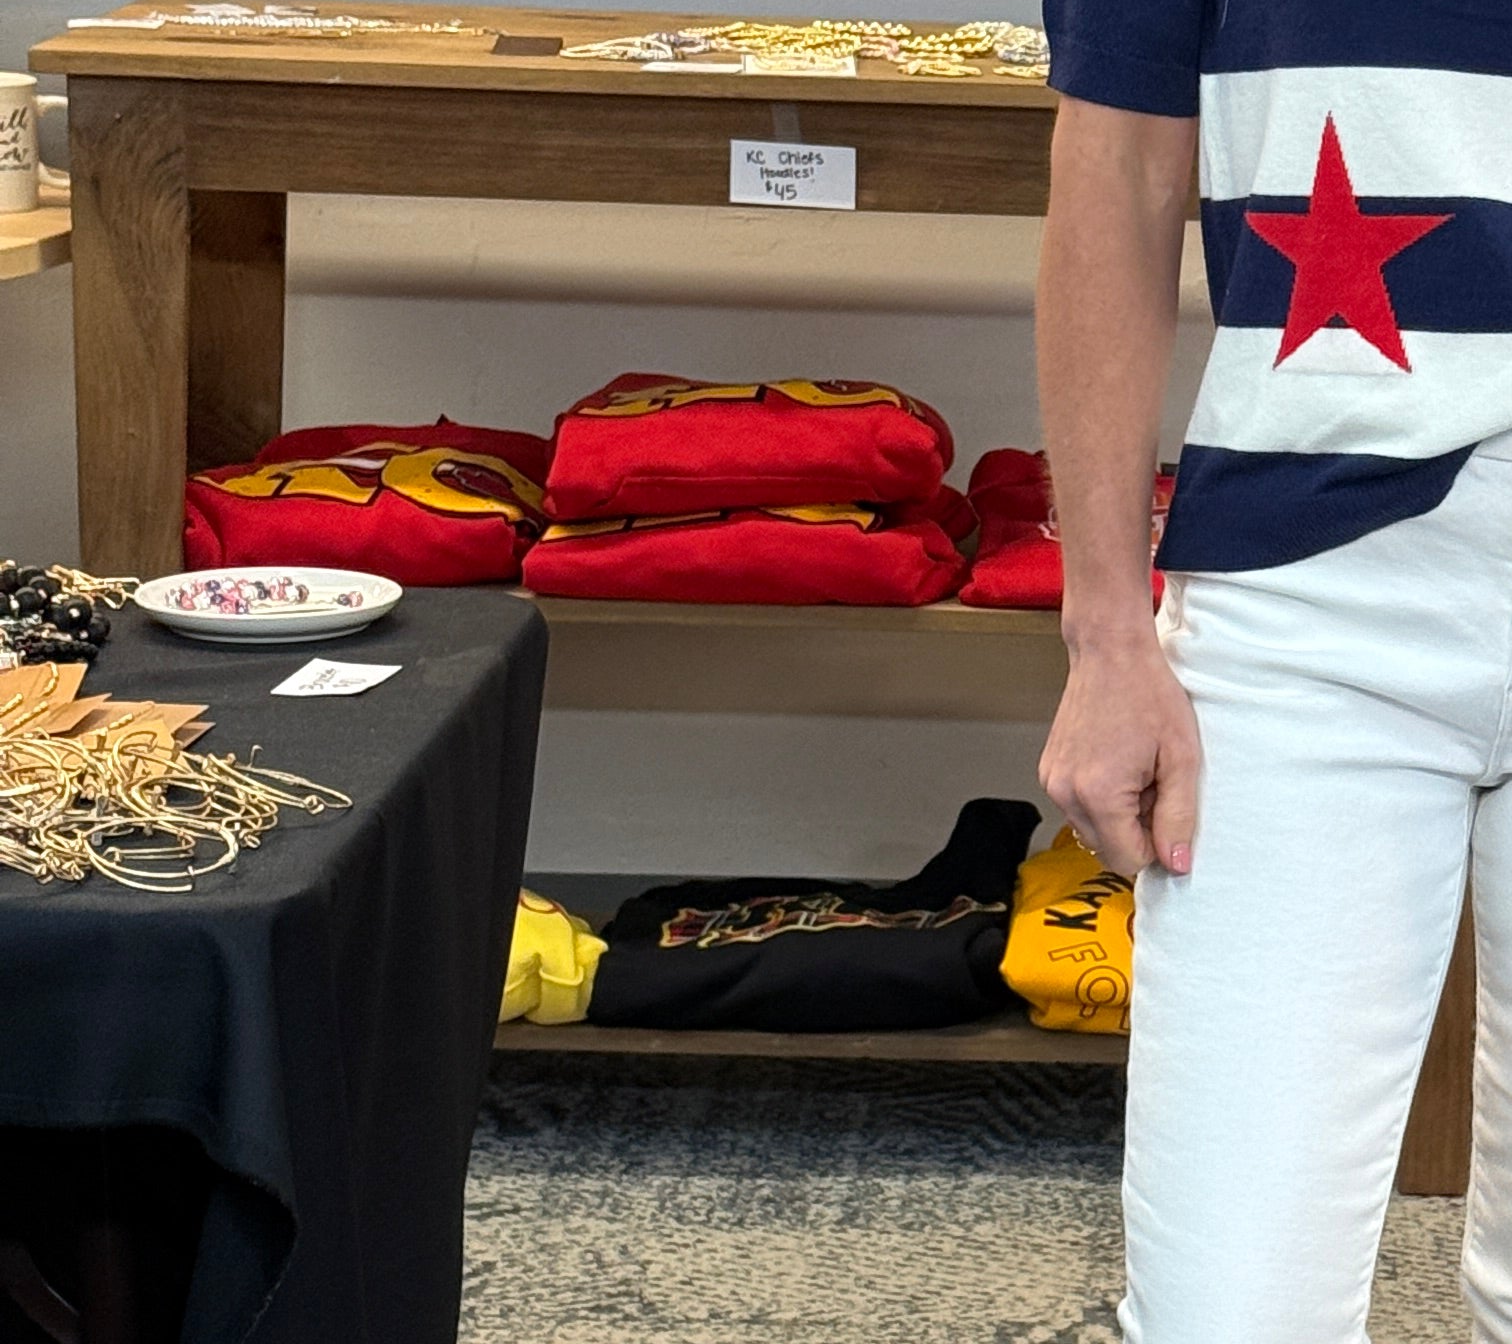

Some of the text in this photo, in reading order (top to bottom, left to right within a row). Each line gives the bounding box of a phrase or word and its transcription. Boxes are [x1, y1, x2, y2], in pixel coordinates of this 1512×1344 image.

[745, 150, 825, 166] KC Chiefs
[765, 180, 798, 201] $45
